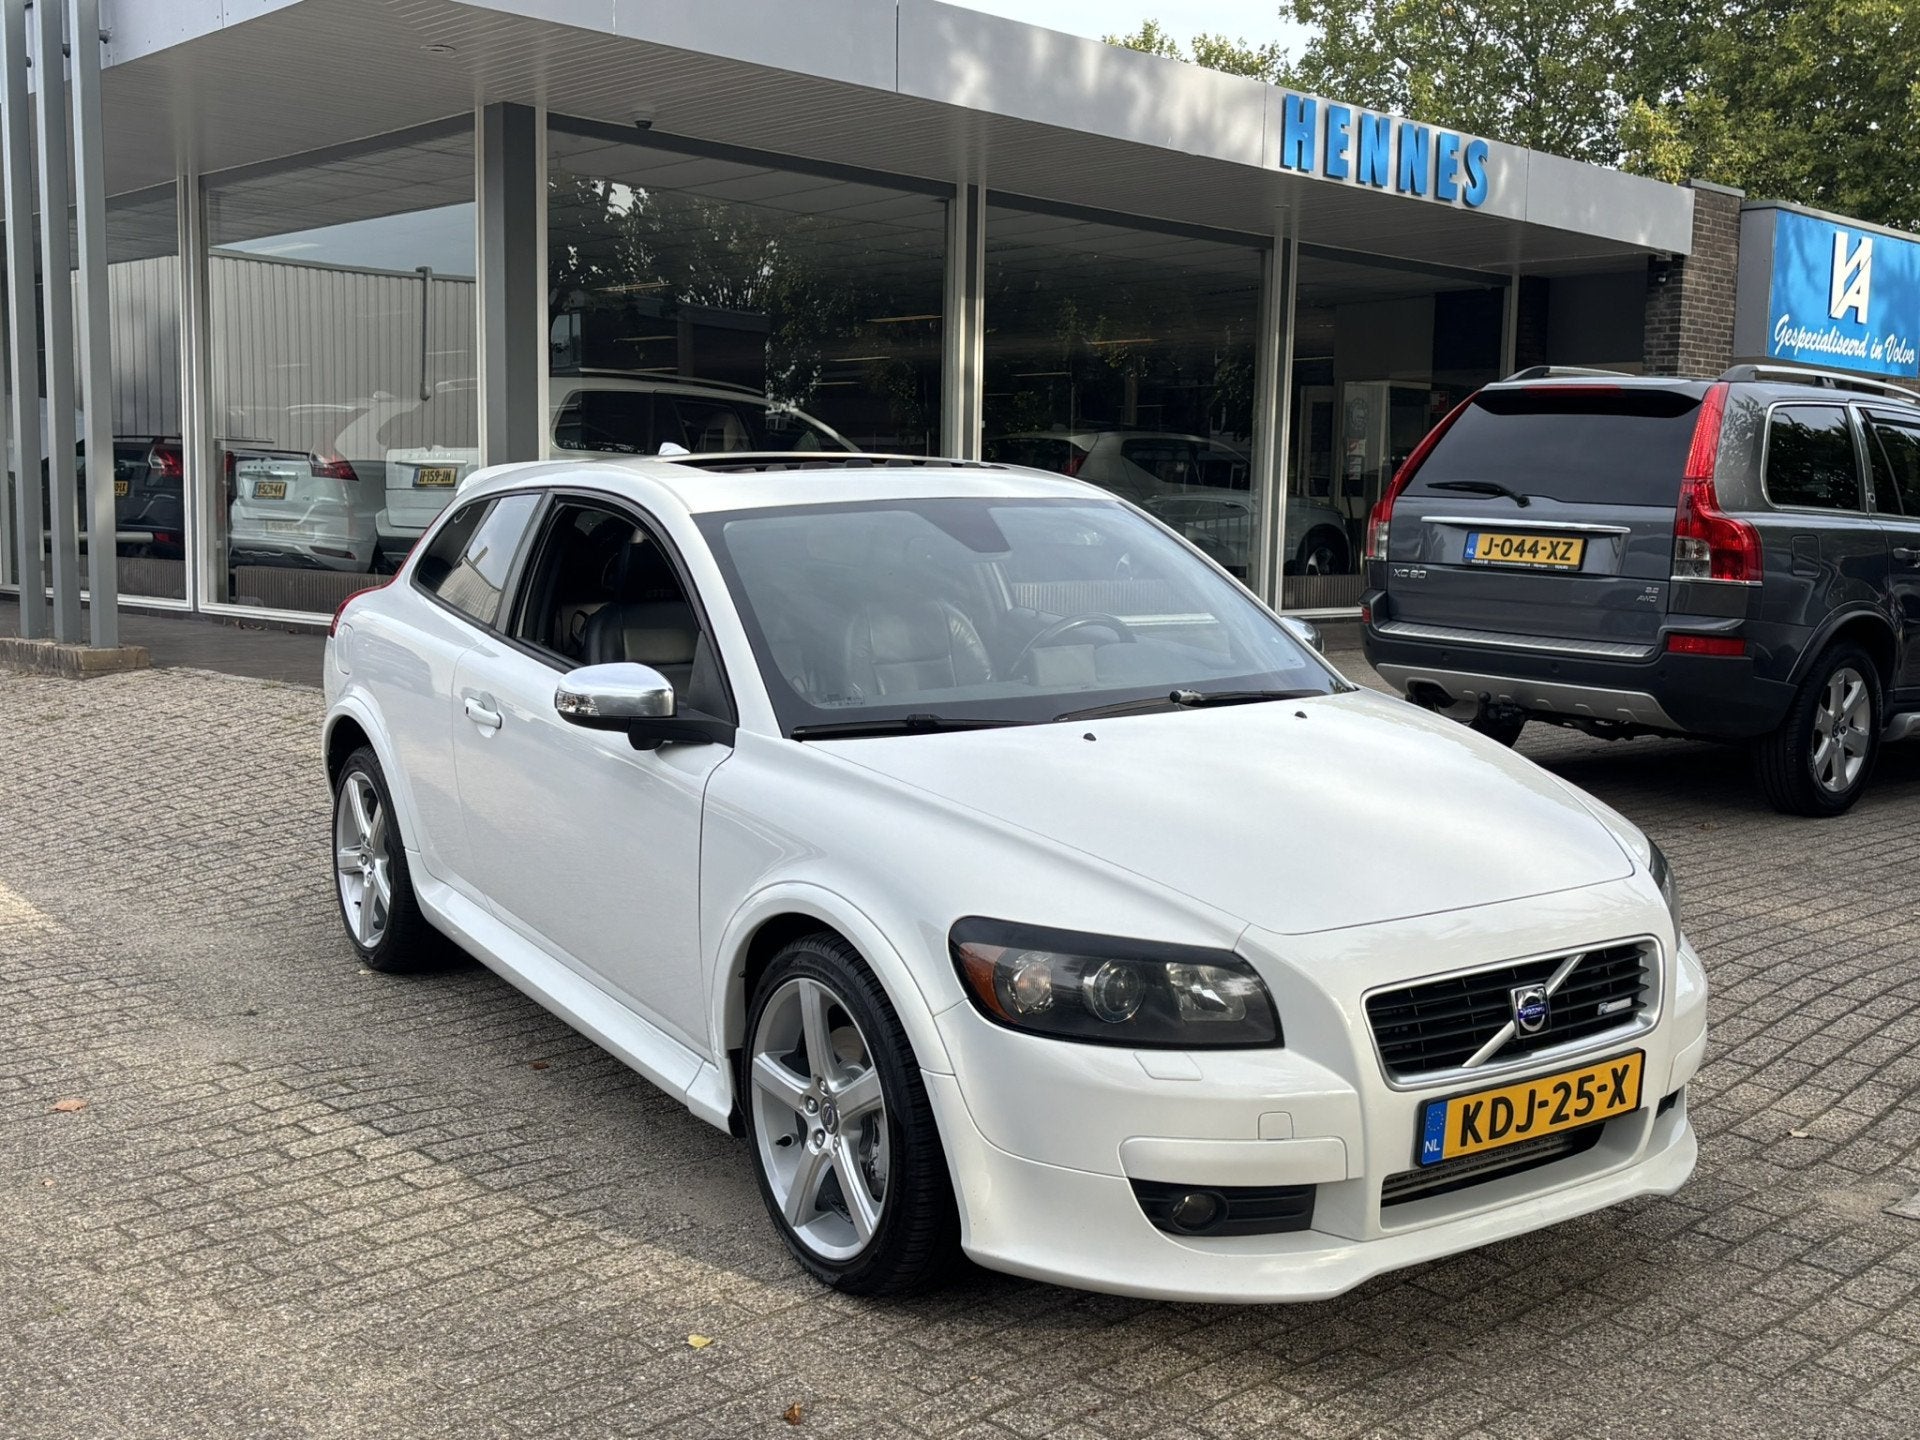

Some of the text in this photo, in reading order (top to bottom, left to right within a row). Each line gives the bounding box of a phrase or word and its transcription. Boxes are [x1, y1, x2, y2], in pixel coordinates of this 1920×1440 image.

[1281, 93, 1489, 208] HENNES
[1774, 313, 1915, 364] Gespecialiseerd in Volvo
[1482, 537, 1574, 561] J-044-XZ
[1460, 1064, 1630, 1147] KDJ-25-X
[1425, 1138, 1441, 1153] NL
